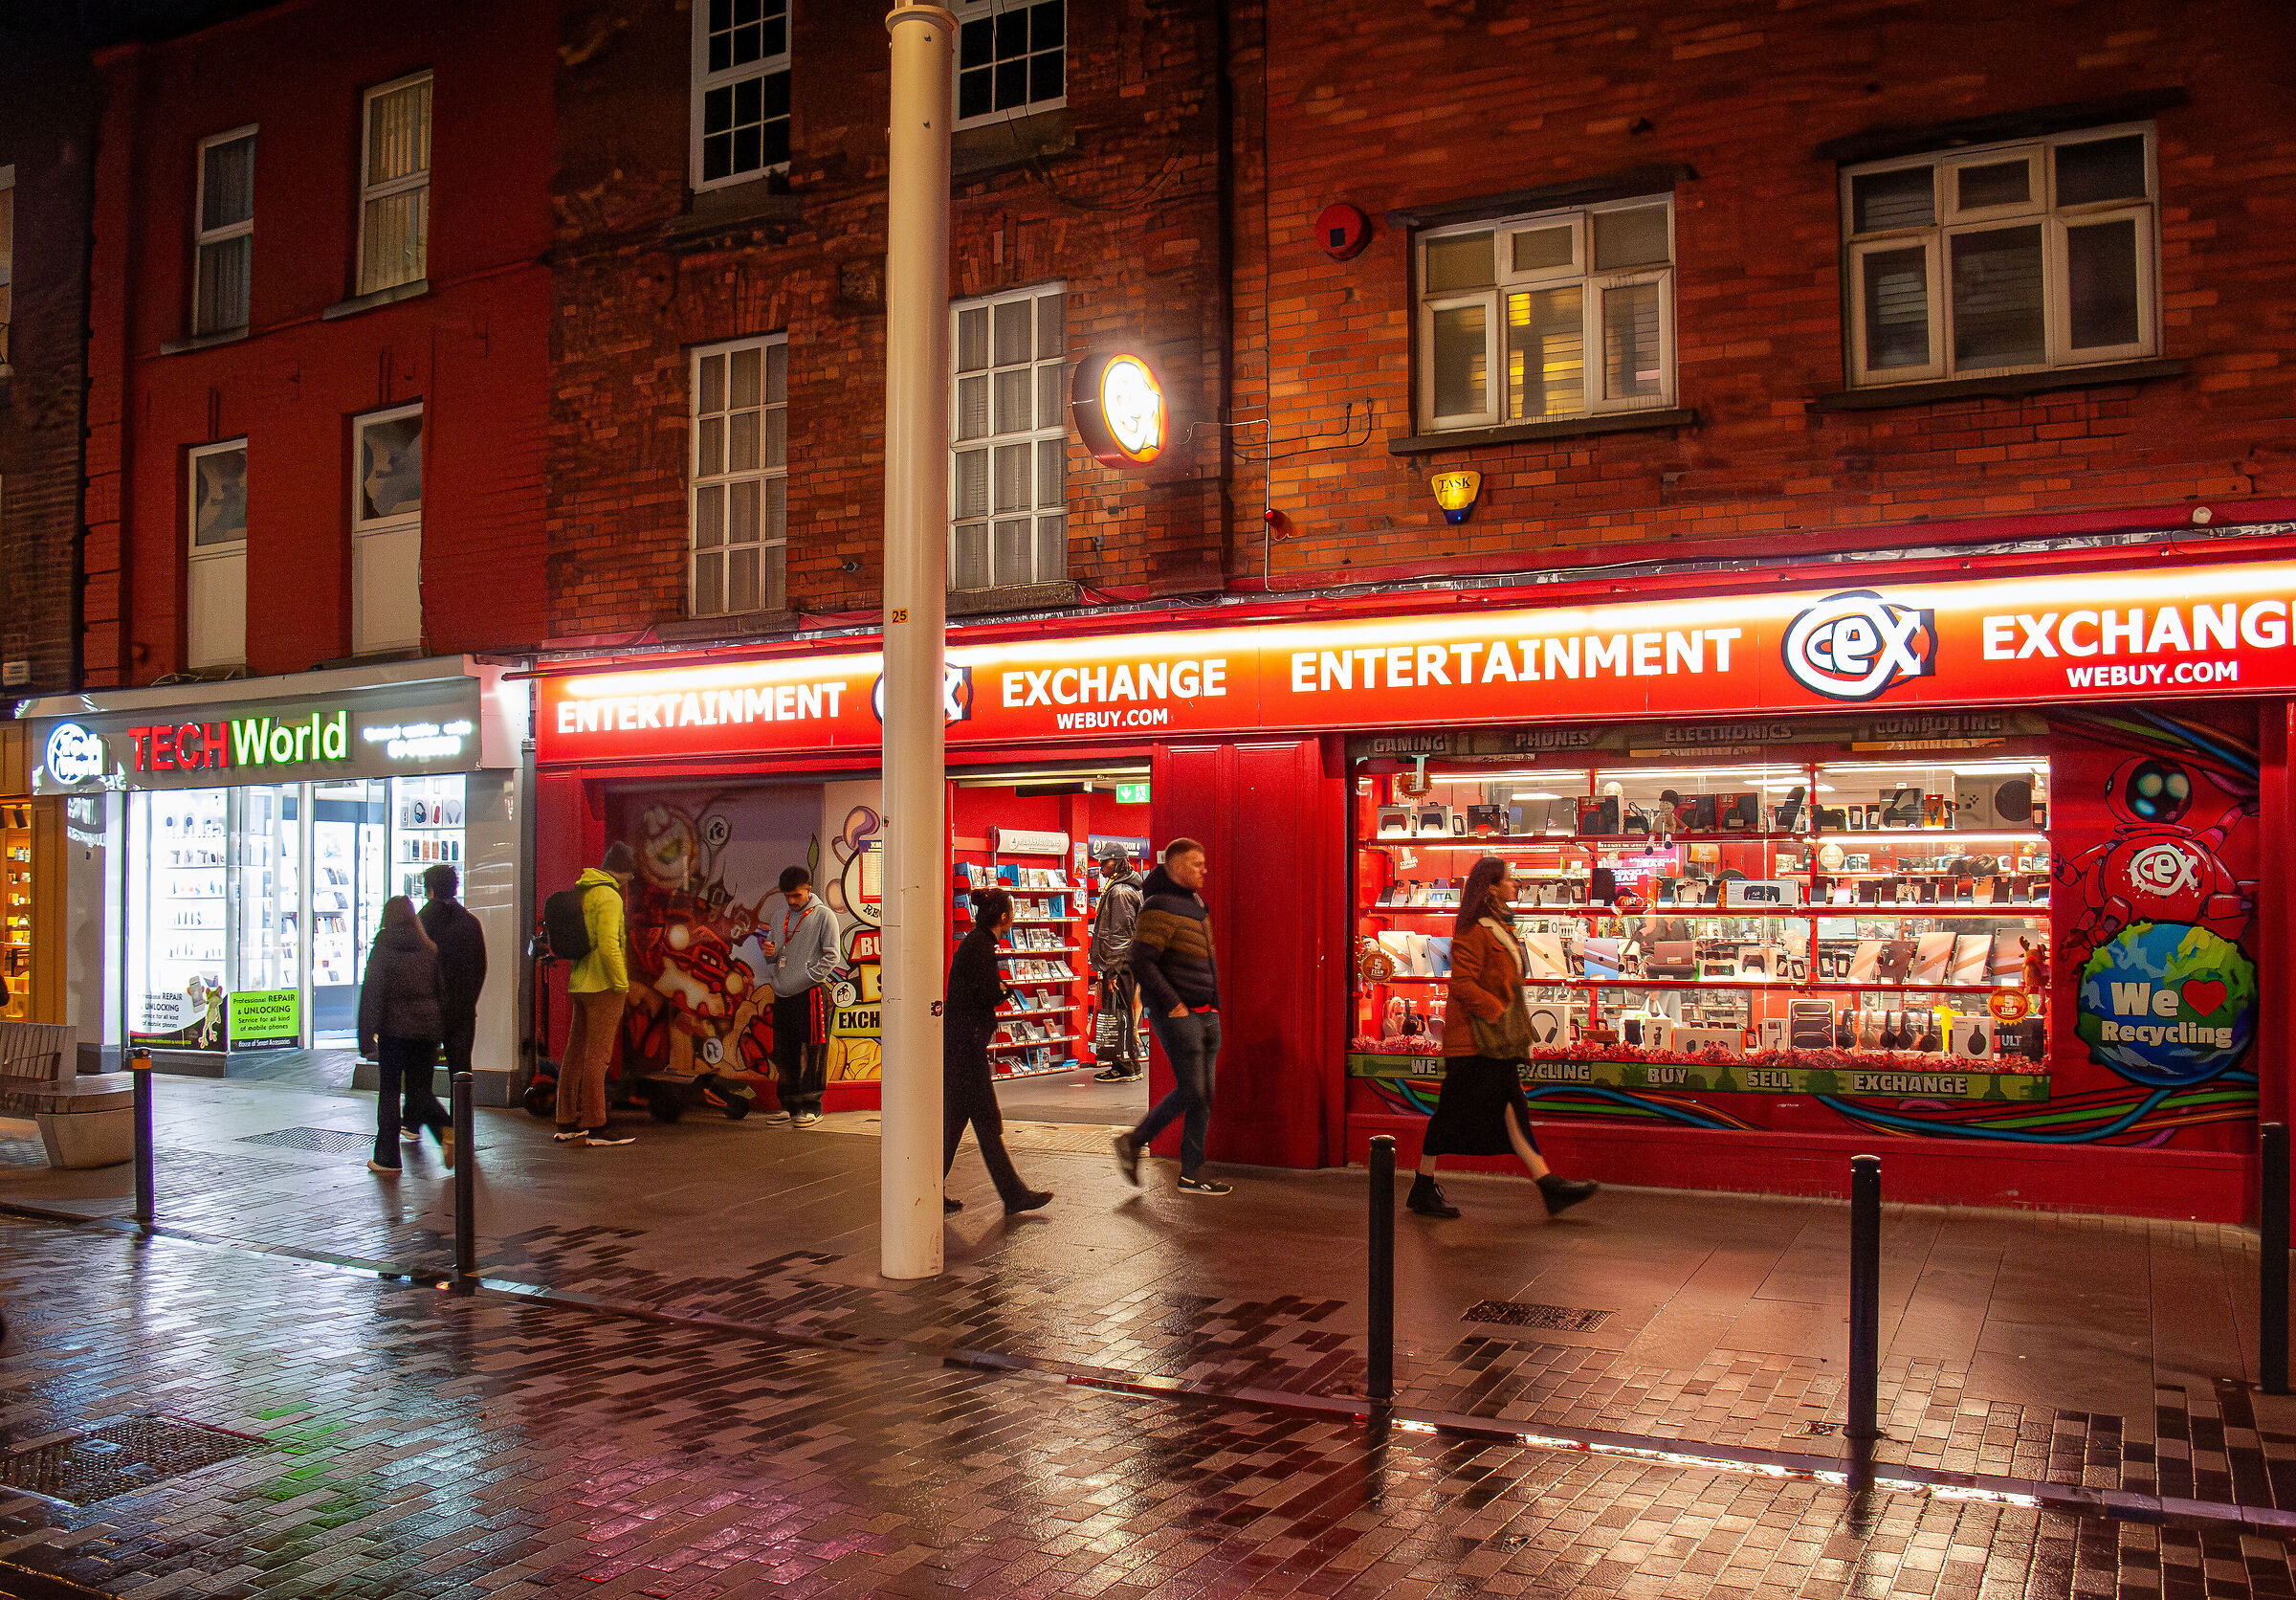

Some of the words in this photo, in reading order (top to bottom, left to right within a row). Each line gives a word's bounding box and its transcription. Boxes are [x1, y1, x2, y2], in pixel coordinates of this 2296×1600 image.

[1438, 477, 1471, 492] TASK
[892, 610, 908, 624] 25
[1982, 600, 2296, 660] EXCHANG
[1292, 628, 1742, 693] ENTERTAINMENT
[1003, 658, 1227, 708] EXCHANGE
[2065, 660, 2239, 688] WEBUY.COM
[558, 681, 848, 734] ENTERTAINMENT
[1056, 708, 1168, 730] WEBUY.COM
[128, 722, 229, 771] TECH
[232, 710, 349, 767] World
[1373, 735, 1446, 753] GAMING
[1514, 731, 1590, 748] PHONES
[162, 992, 183, 1001] REPAIR
[268, 993, 296, 1003] REPAIR
[2004, 994, 2015, 1008] 5
[2110, 982, 2179, 1017] We
[243, 1005, 291, 1015] UNLOCKING
[839, 1011, 881, 1029] EXCH
[2102, 1020, 2233, 1049] Recycling
[1410, 1058, 1437, 1076] WE
[1647, 1067, 1689, 1084] BUY
[1747, 1071, 1793, 1088] SELL
[1852, 1073, 1969, 1094] EXCHANGE
